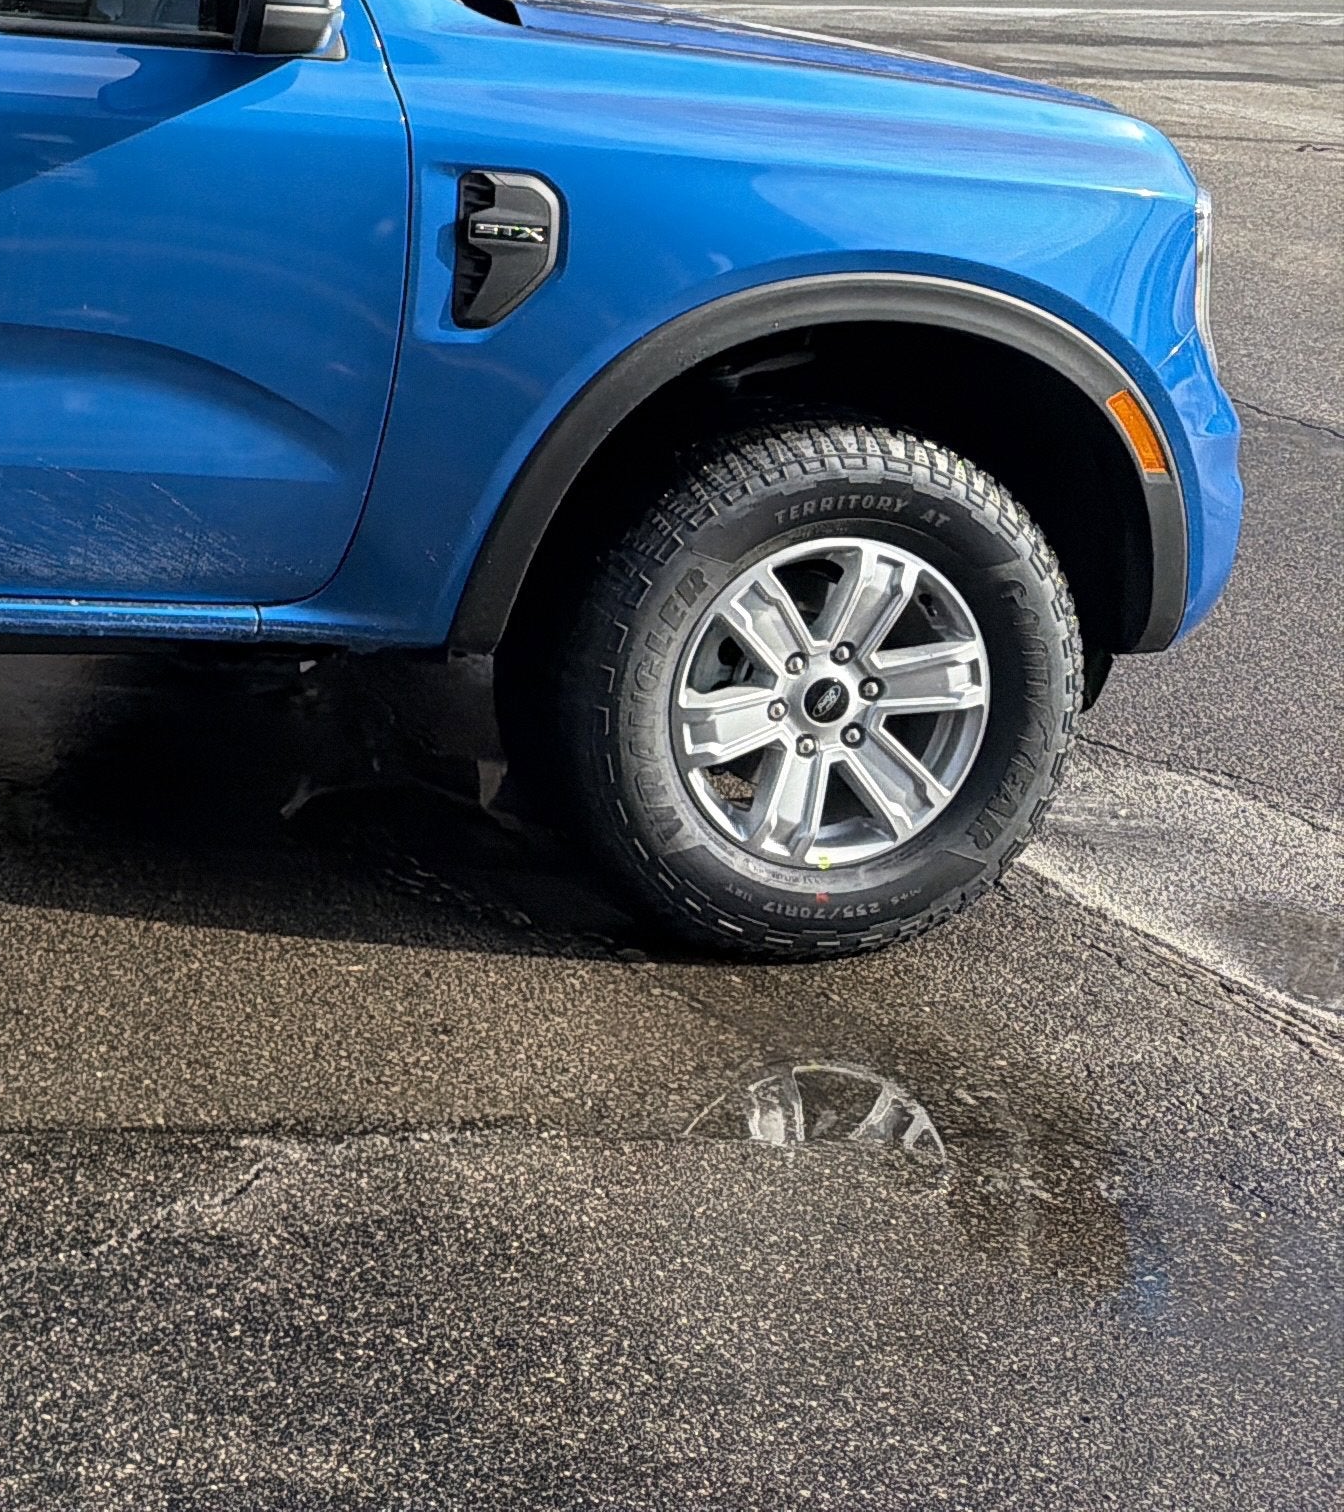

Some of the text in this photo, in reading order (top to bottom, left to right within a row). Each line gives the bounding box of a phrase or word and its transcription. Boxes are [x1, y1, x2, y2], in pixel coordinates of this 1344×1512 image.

[774, 494, 951, 528] TERRITORY AT
[628, 566, 710, 841] WRANGLER
[762, 901, 881, 920] 255/70R17
